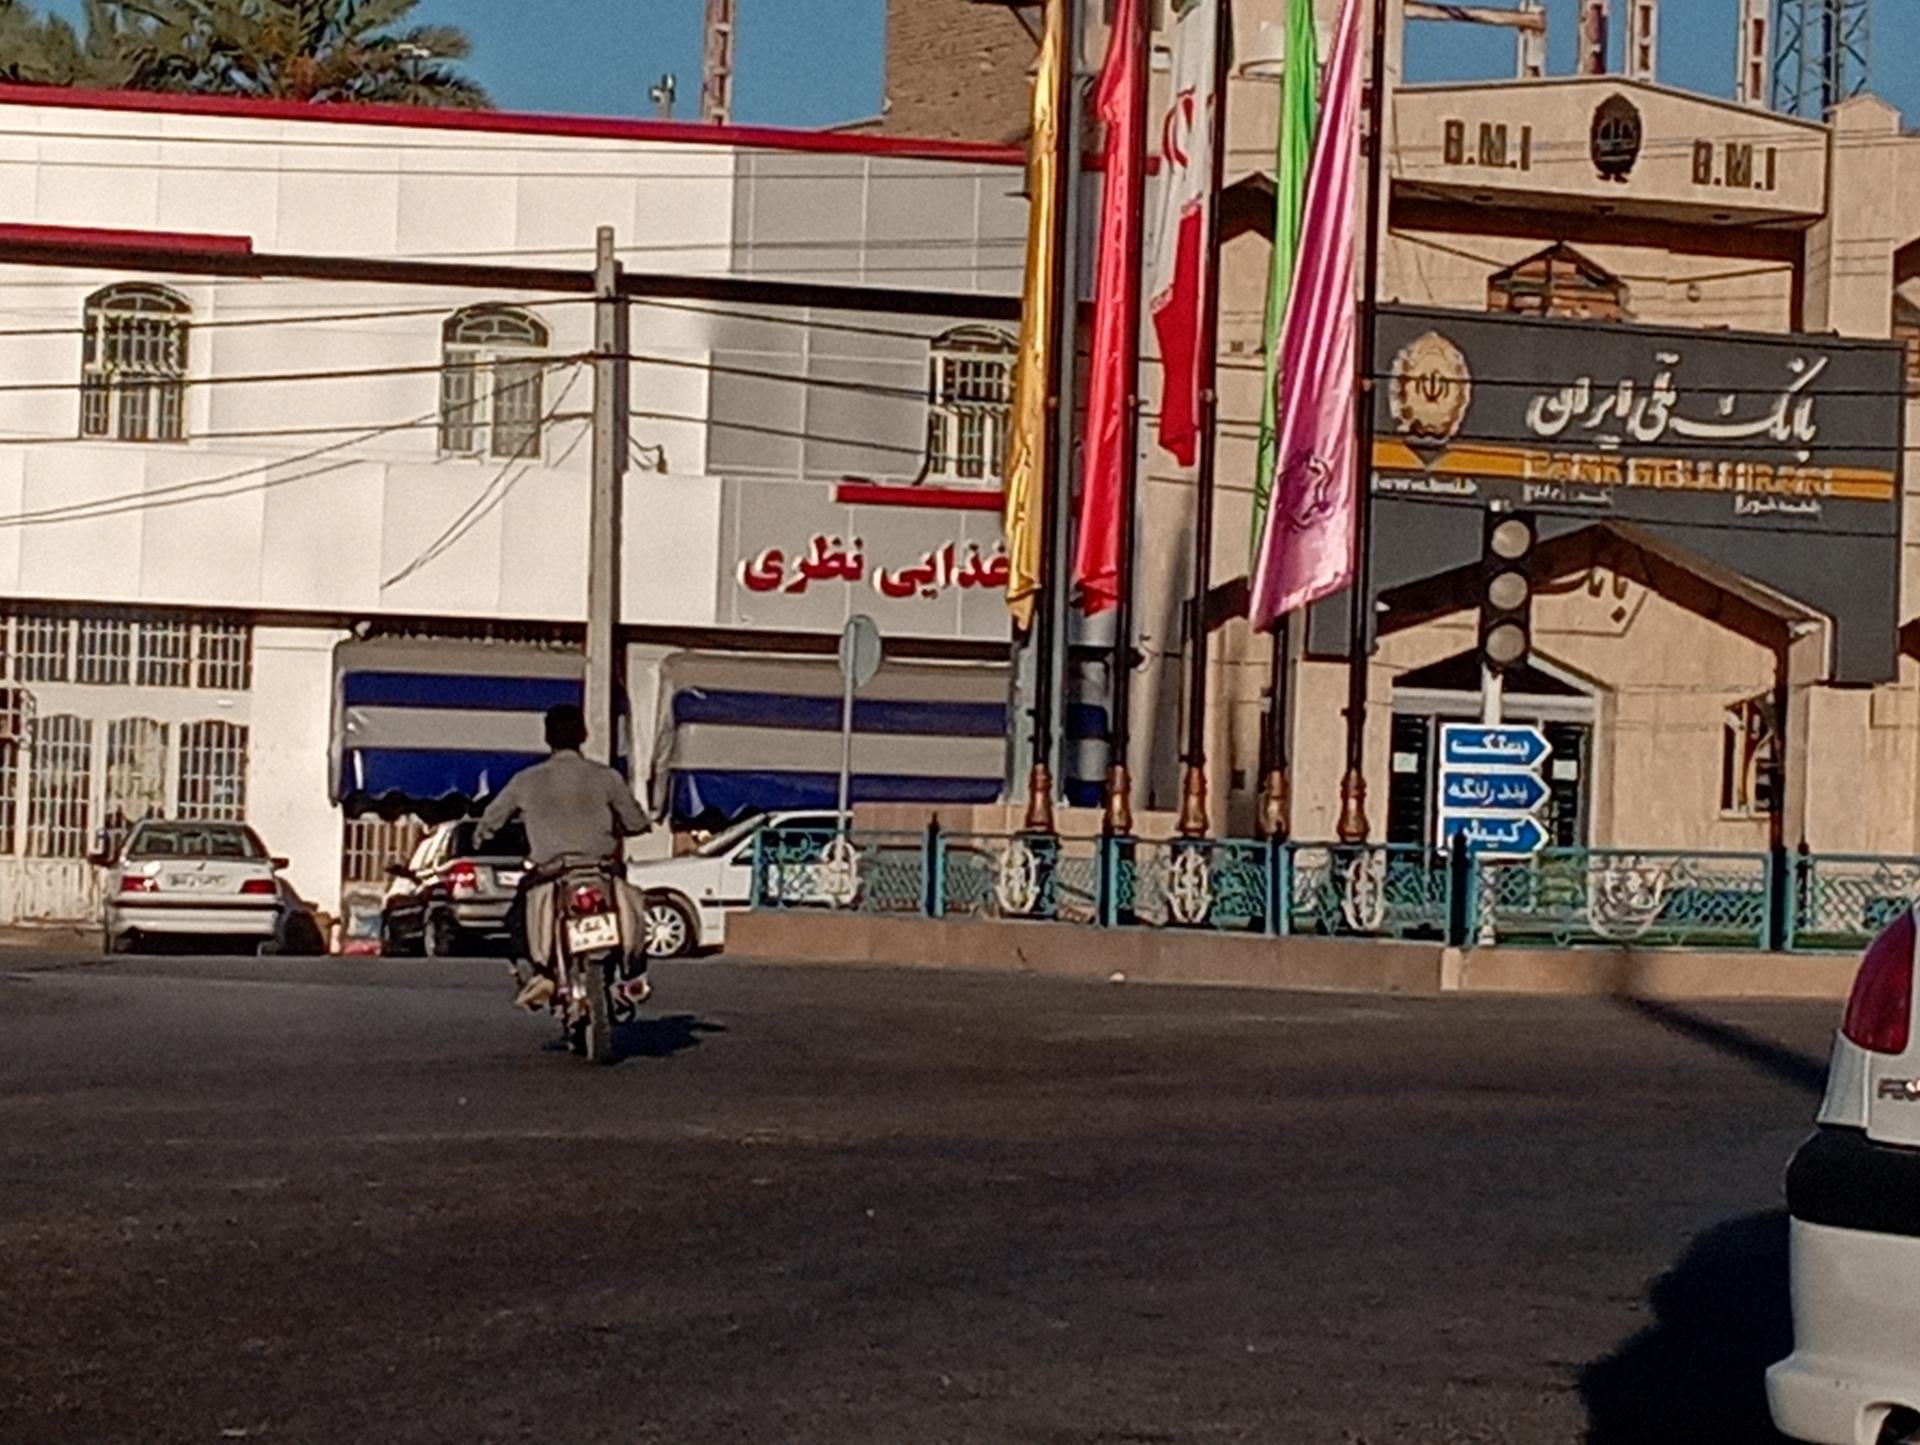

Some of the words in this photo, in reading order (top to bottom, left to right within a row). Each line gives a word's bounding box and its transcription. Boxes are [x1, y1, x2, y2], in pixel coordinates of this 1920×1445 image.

[1443, 119, 1532, 172] B.M.I
[1692, 139, 1776, 191] B.M.I
[1526, 376, 1635, 450] ایران
[1627, 352, 1678, 442] ملی
[1669, 355, 1829, 462] بانک
[1523, 446, 1622, 484] BANK
[741, 534, 864, 594] نظری
[1451, 733, 1530, 762] بستک
